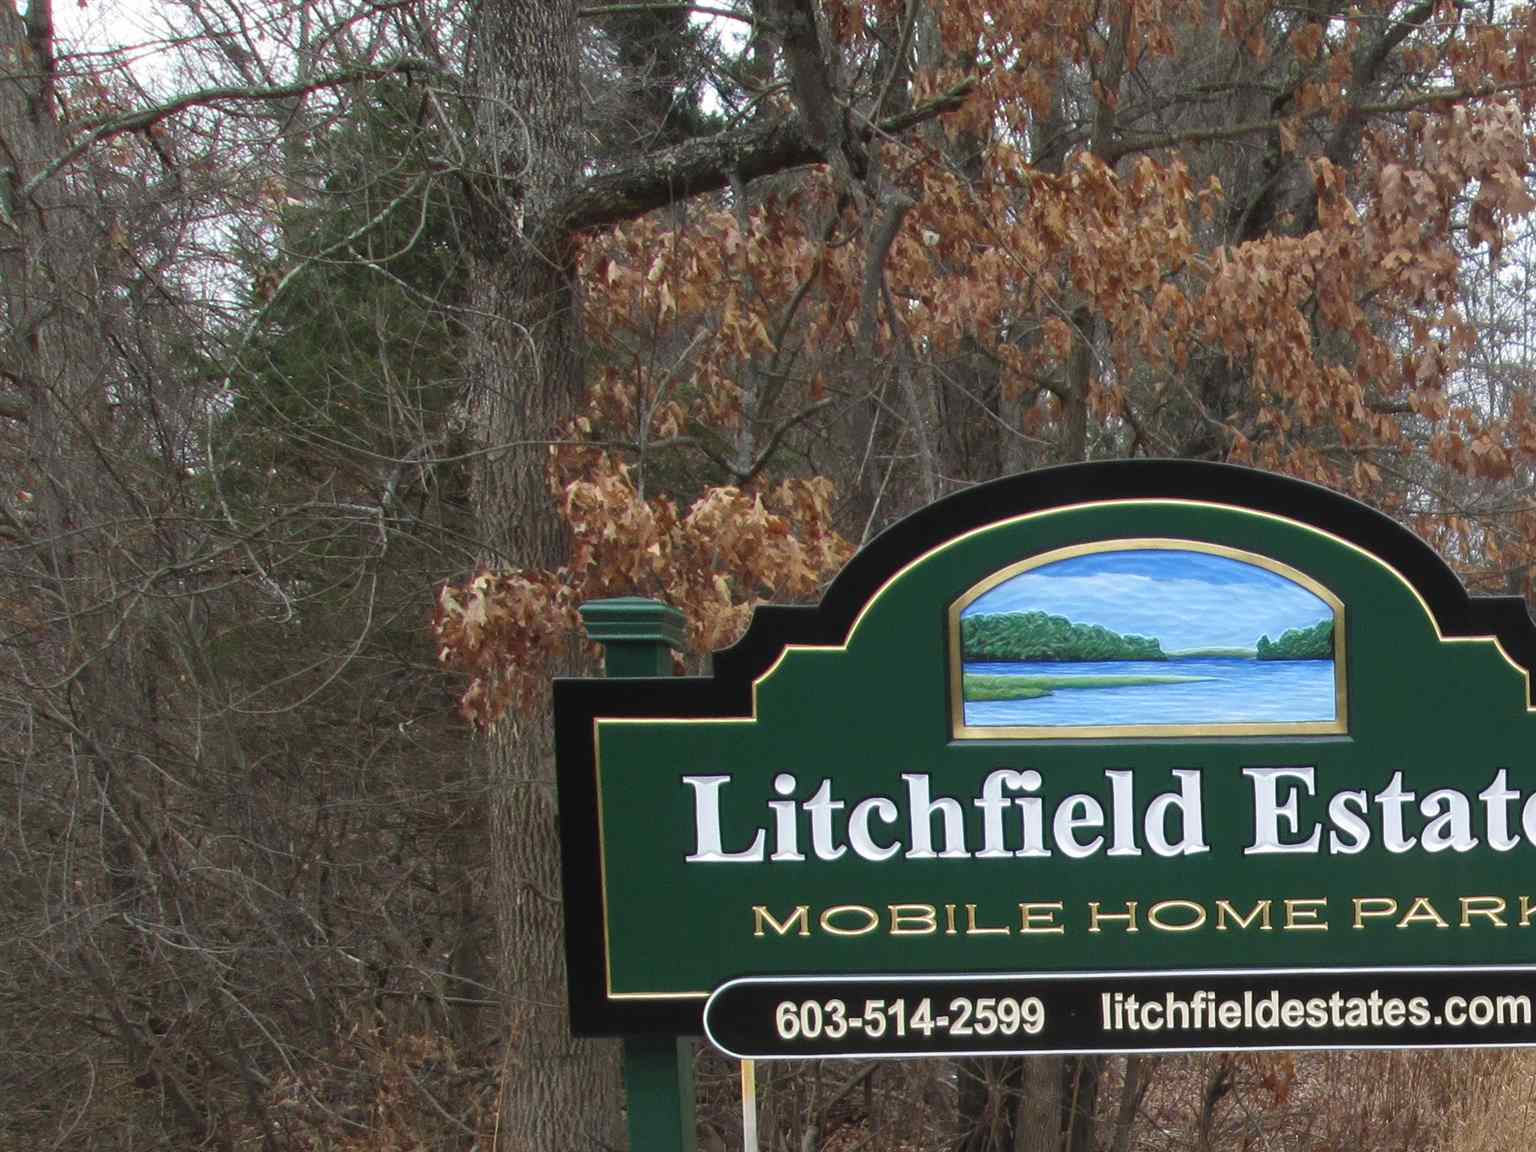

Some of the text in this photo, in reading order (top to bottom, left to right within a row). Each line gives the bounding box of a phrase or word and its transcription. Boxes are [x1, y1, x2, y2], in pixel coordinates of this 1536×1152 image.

[682, 768, 1210, 862] Litchfield
[751, 901, 1065, 937] MOBILE
[1087, 896, 1329, 933] HOME
[775, 989, 1532, 1040] 603-514-2599 litchfieldestates.com
